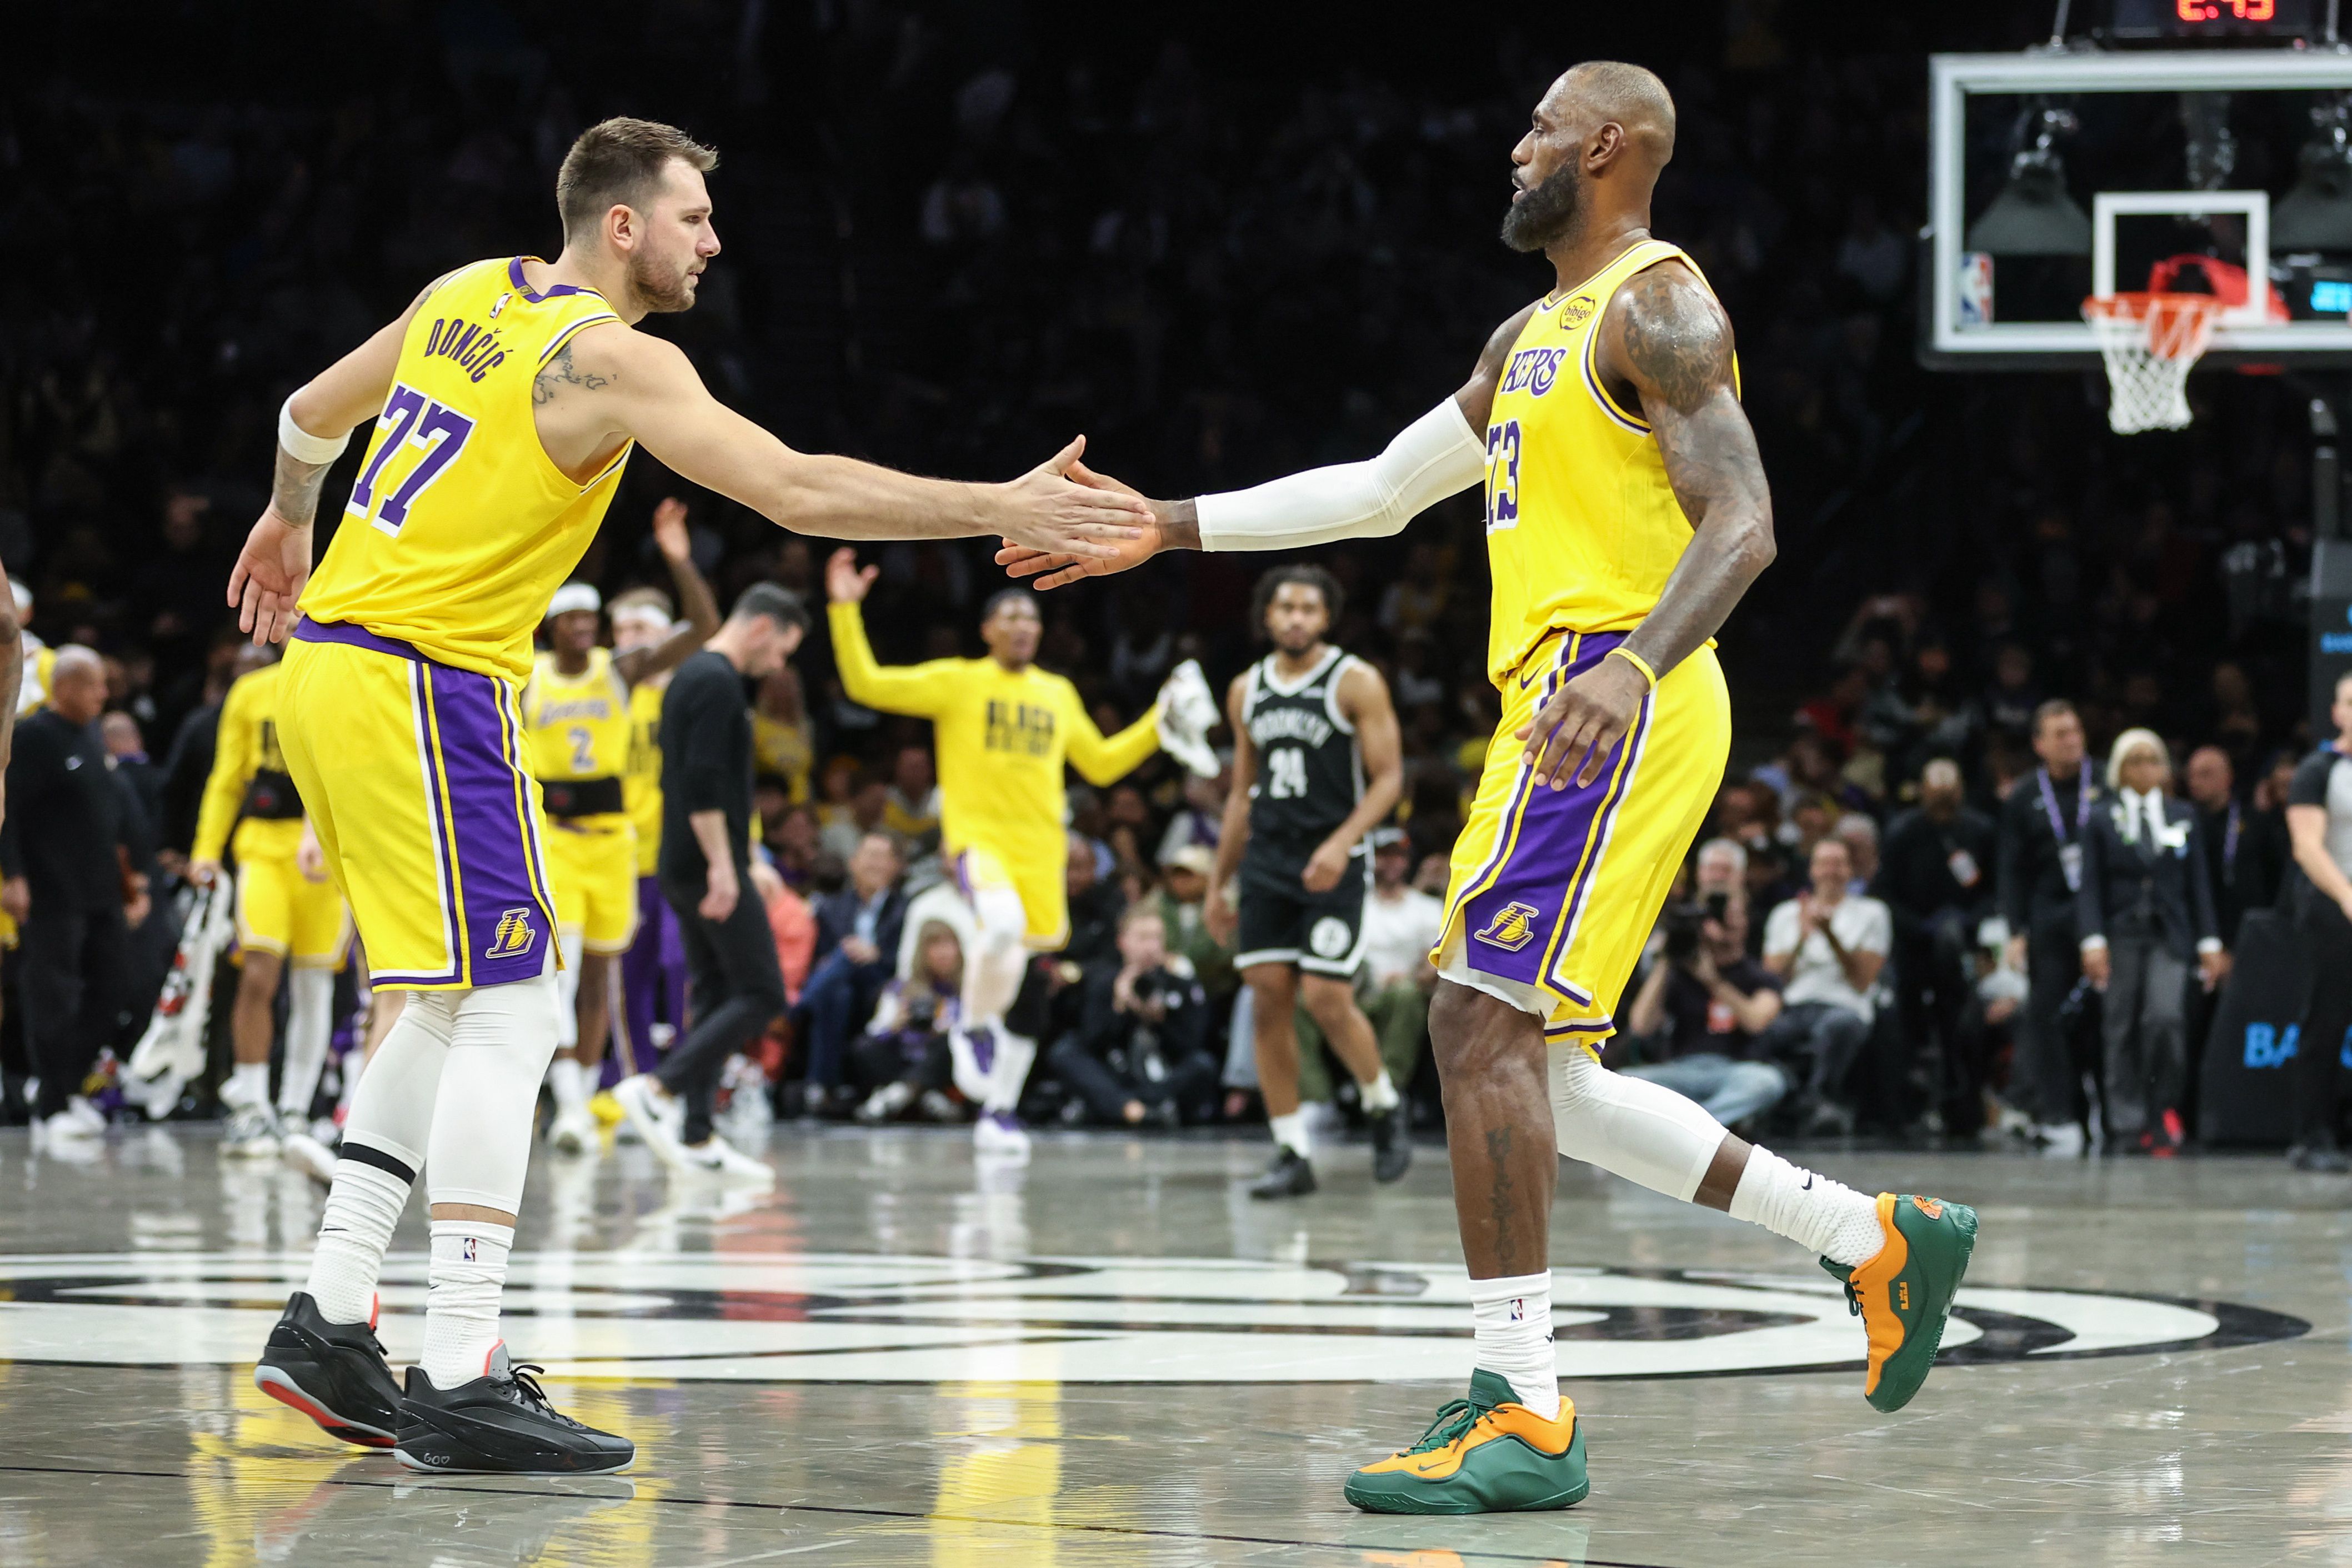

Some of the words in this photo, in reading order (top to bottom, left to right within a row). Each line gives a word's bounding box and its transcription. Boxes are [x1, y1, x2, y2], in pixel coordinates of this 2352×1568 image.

[1564, 304, 1591, 321] bibigo
[424, 318, 513, 383] DONČIĆ
[1500, 347, 1568, 397] KERS
[345, 380, 478, 539] 77
[567, 727, 597, 774] 2
[1268, 746, 1309, 800] 24
